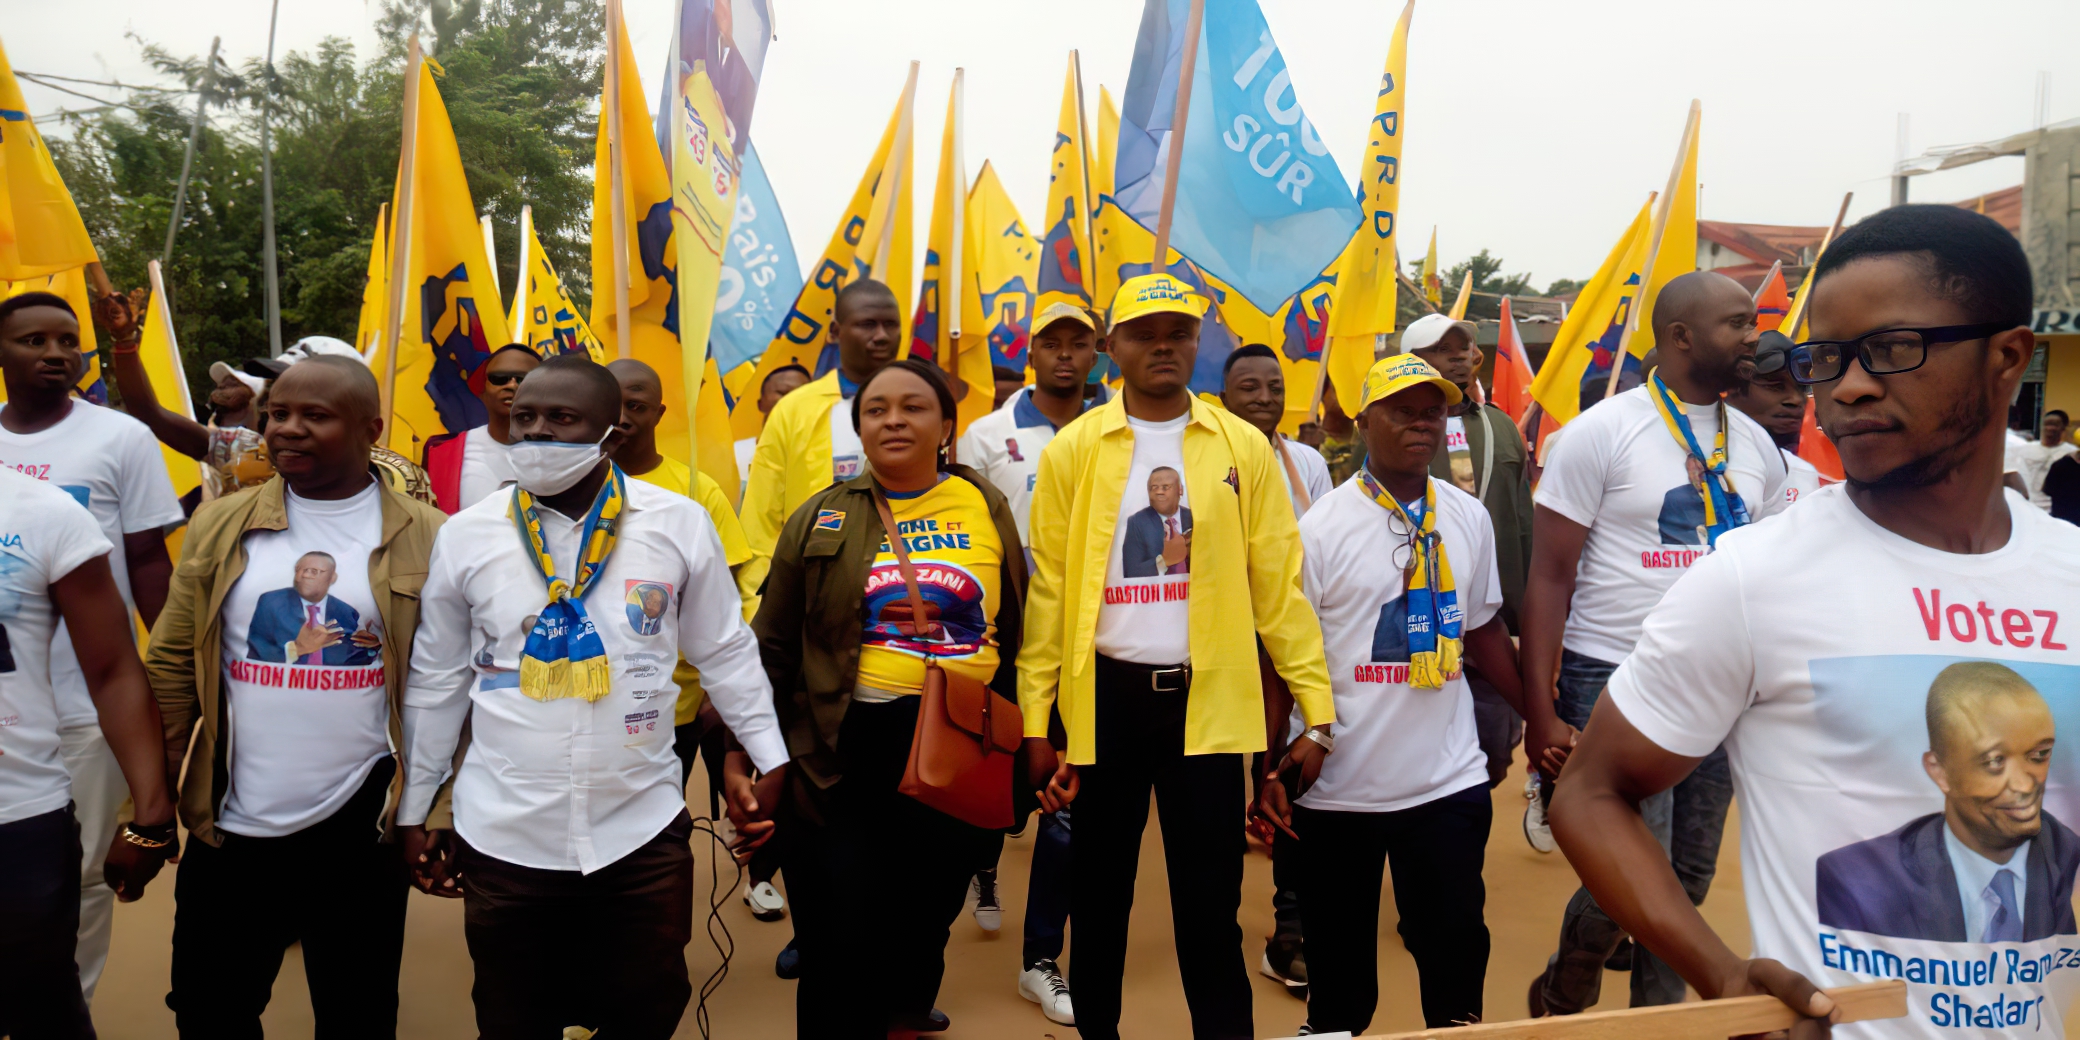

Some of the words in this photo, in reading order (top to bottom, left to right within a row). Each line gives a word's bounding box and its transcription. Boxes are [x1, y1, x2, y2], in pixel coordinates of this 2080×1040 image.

[1223, 113, 1315, 206] SÛR
[1163, 581, 1190, 602] MU
[1912, 587, 2067, 651] Votez
[1819, 932, 1998, 986] Emmanuel
